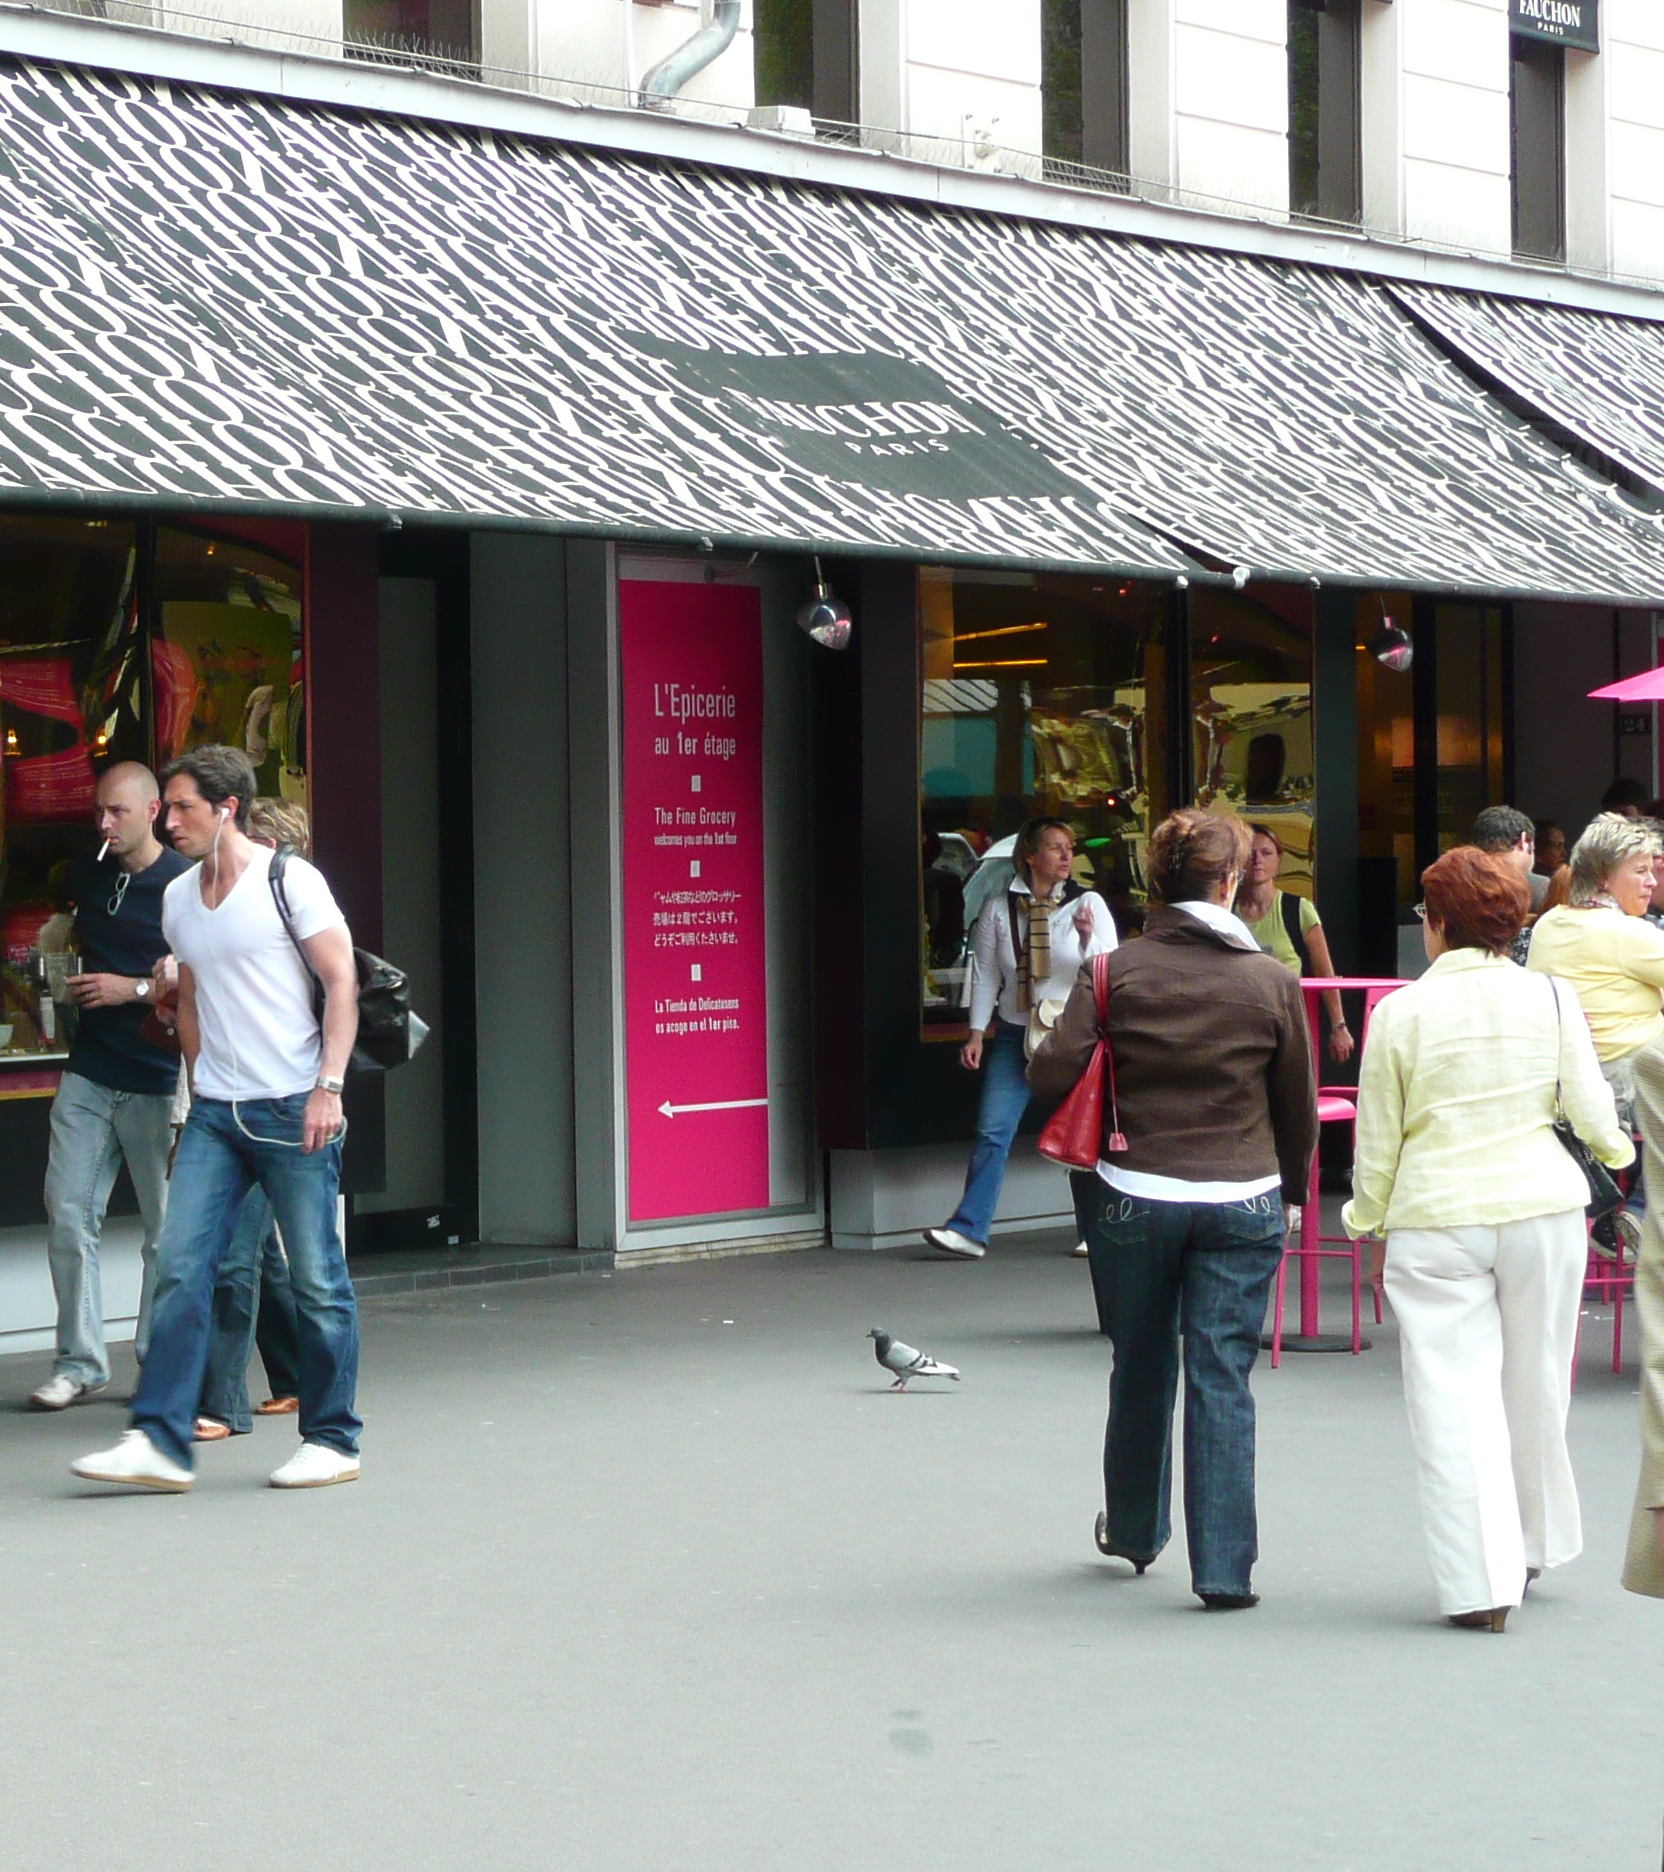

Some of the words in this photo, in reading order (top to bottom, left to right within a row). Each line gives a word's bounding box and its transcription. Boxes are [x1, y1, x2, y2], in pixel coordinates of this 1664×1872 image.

[1519, 0, 1581, 28] FAUCHON
[1537, 21, 1564, 36] PARIS
[721, 385, 986, 438] FAUCHON
[844, 437, 950, 457] PARIS
[654, 683, 736, 725] L'Epicerie
[655, 737, 670, 755] au
[677, 731, 698, 755] 1er
[704, 731, 736, 761] étage
[654, 807, 673, 825] The
[676, 807, 696, 825] Fine
[699, 806, 736, 828] Grocery
[655, 999, 663, 1013] La
[665, 998, 687, 1012] Tienda
[689, 997, 697, 1011] de
[655, 1022, 664, 1034] os
[666, 1021, 687, 1036] acoge
[689, 1021, 698, 1032] en
[700, 1017, 706, 1031] el
[709, 1016, 721, 1031] 1er
